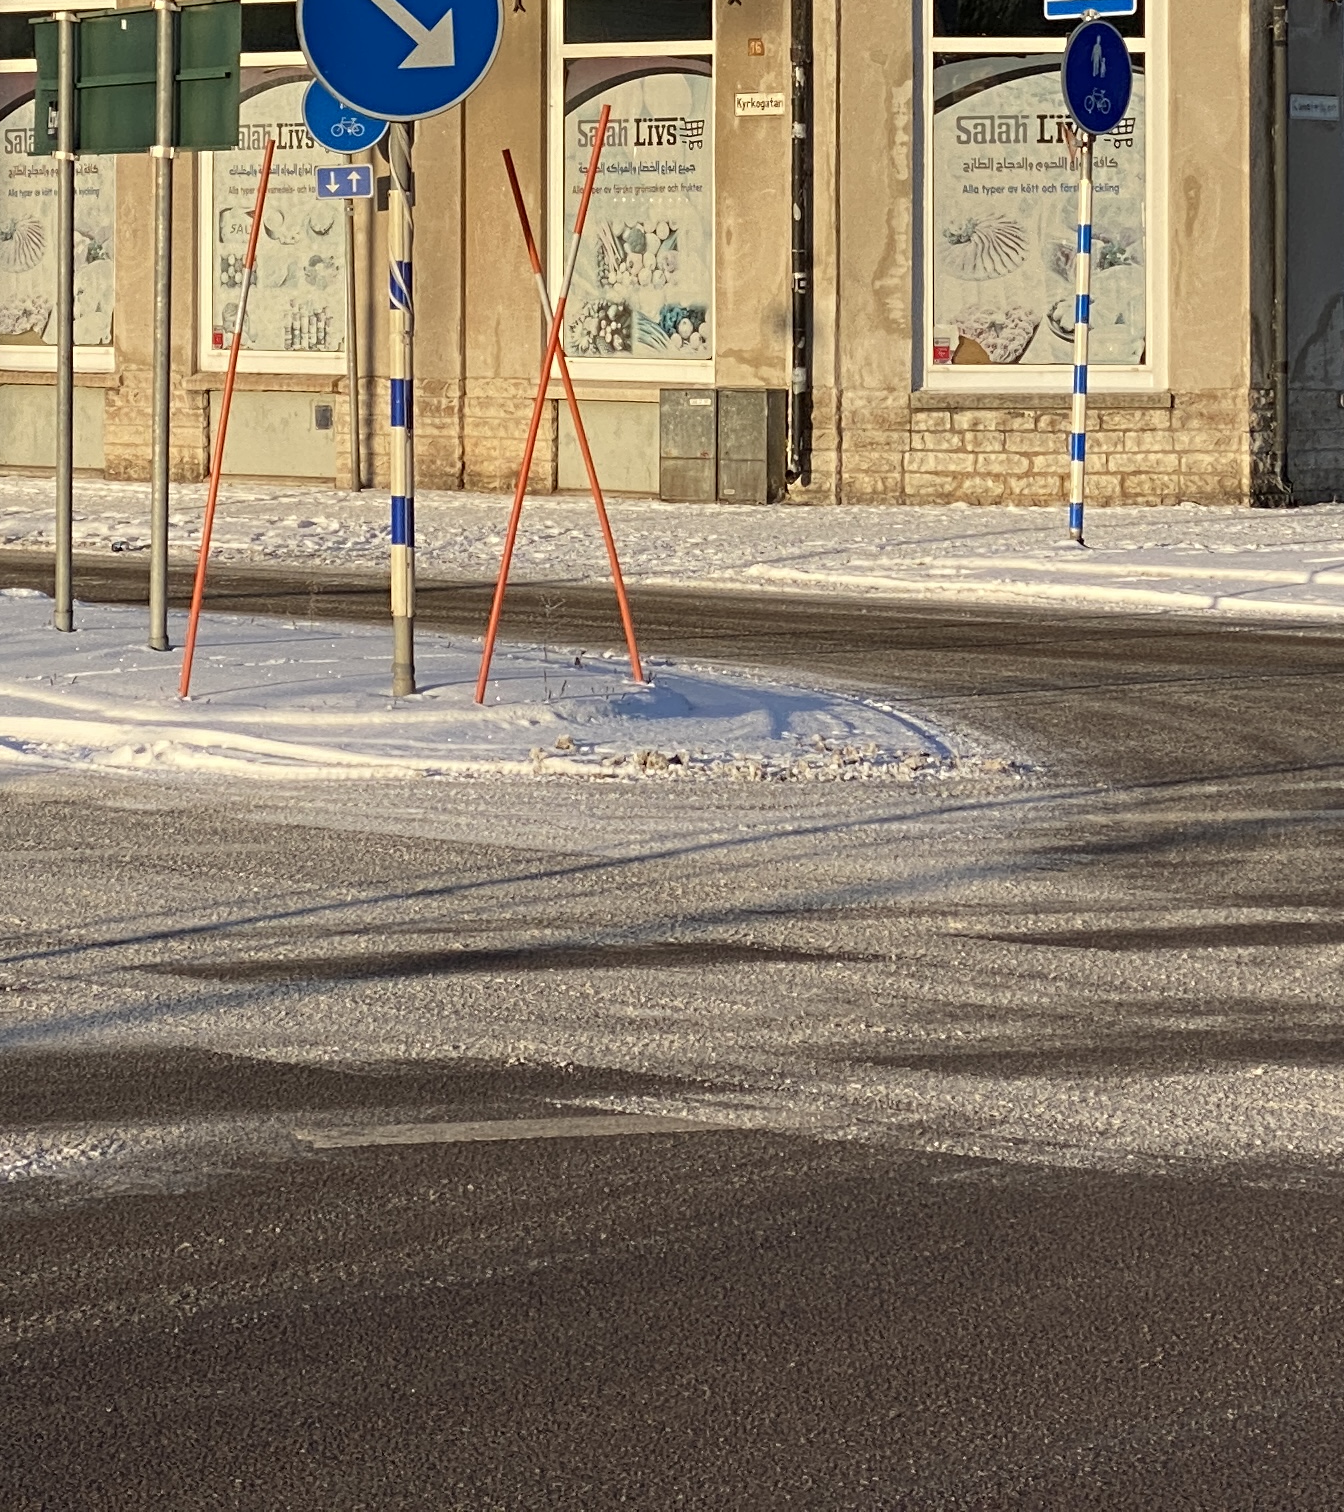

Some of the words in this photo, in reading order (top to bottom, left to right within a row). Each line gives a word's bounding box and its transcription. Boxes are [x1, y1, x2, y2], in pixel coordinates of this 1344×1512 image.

[749, 41, 762, 54] 16
[736, 97, 783, 111] Kyrkogatan
[633, 117, 678, 147] Livs
[956, 114, 1030, 145] Salah
[962, 184, 979, 194] Alla
[982, 184, 1005, 196] typer
